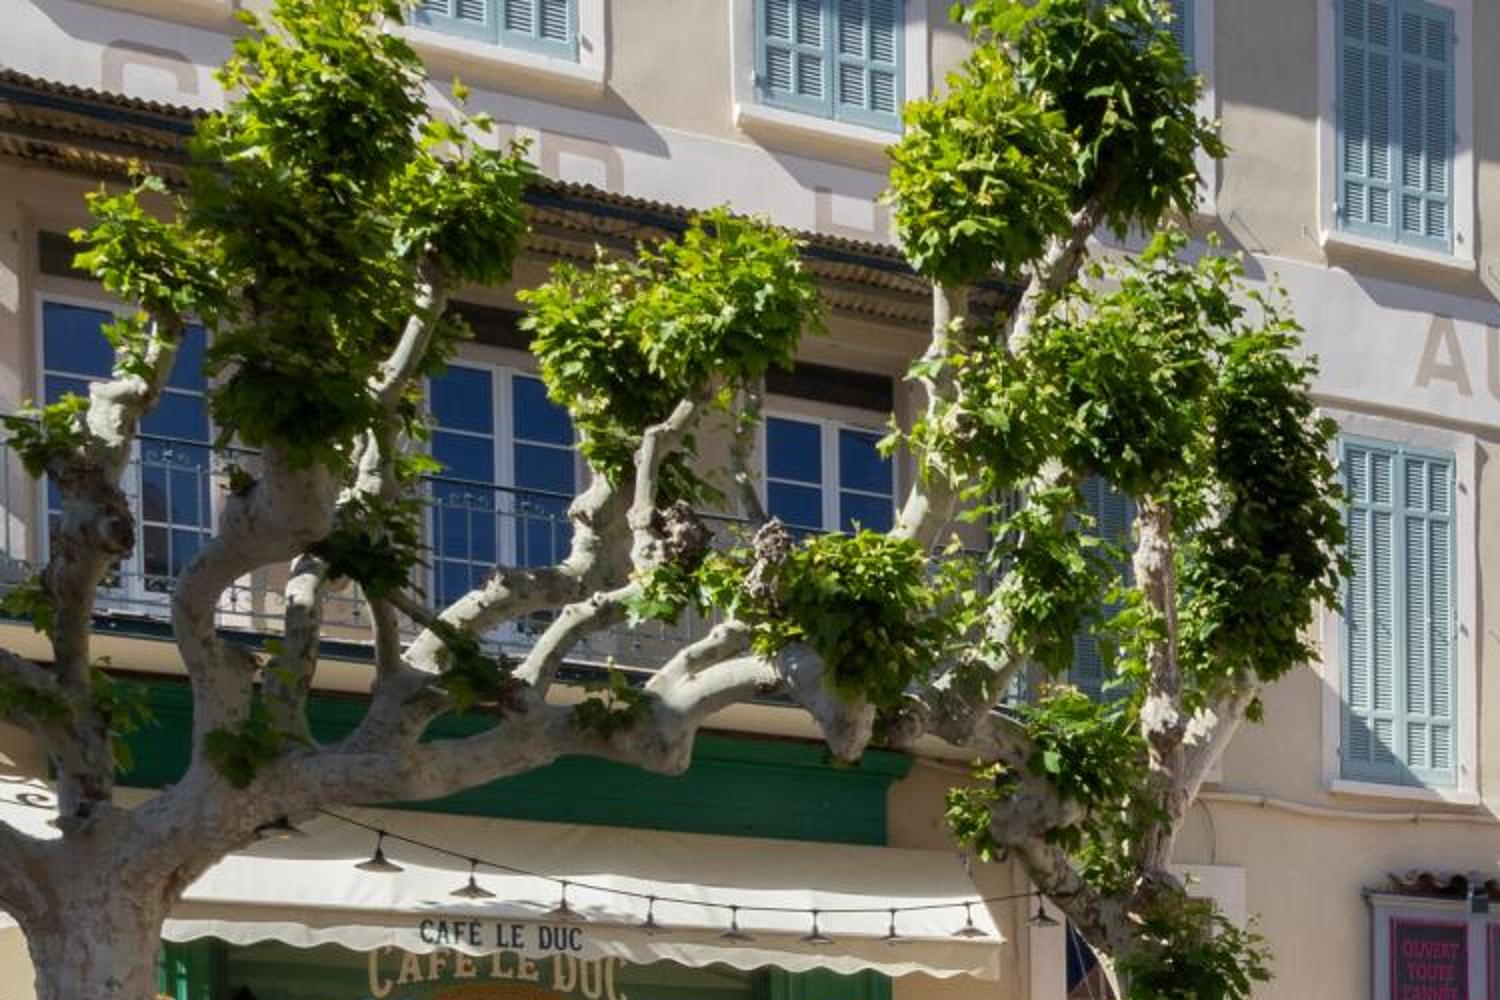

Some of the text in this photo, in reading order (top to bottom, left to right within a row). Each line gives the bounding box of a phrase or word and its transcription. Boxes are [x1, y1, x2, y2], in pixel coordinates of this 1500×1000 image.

[420, 919, 583, 951] CAFÉ LE DUC
